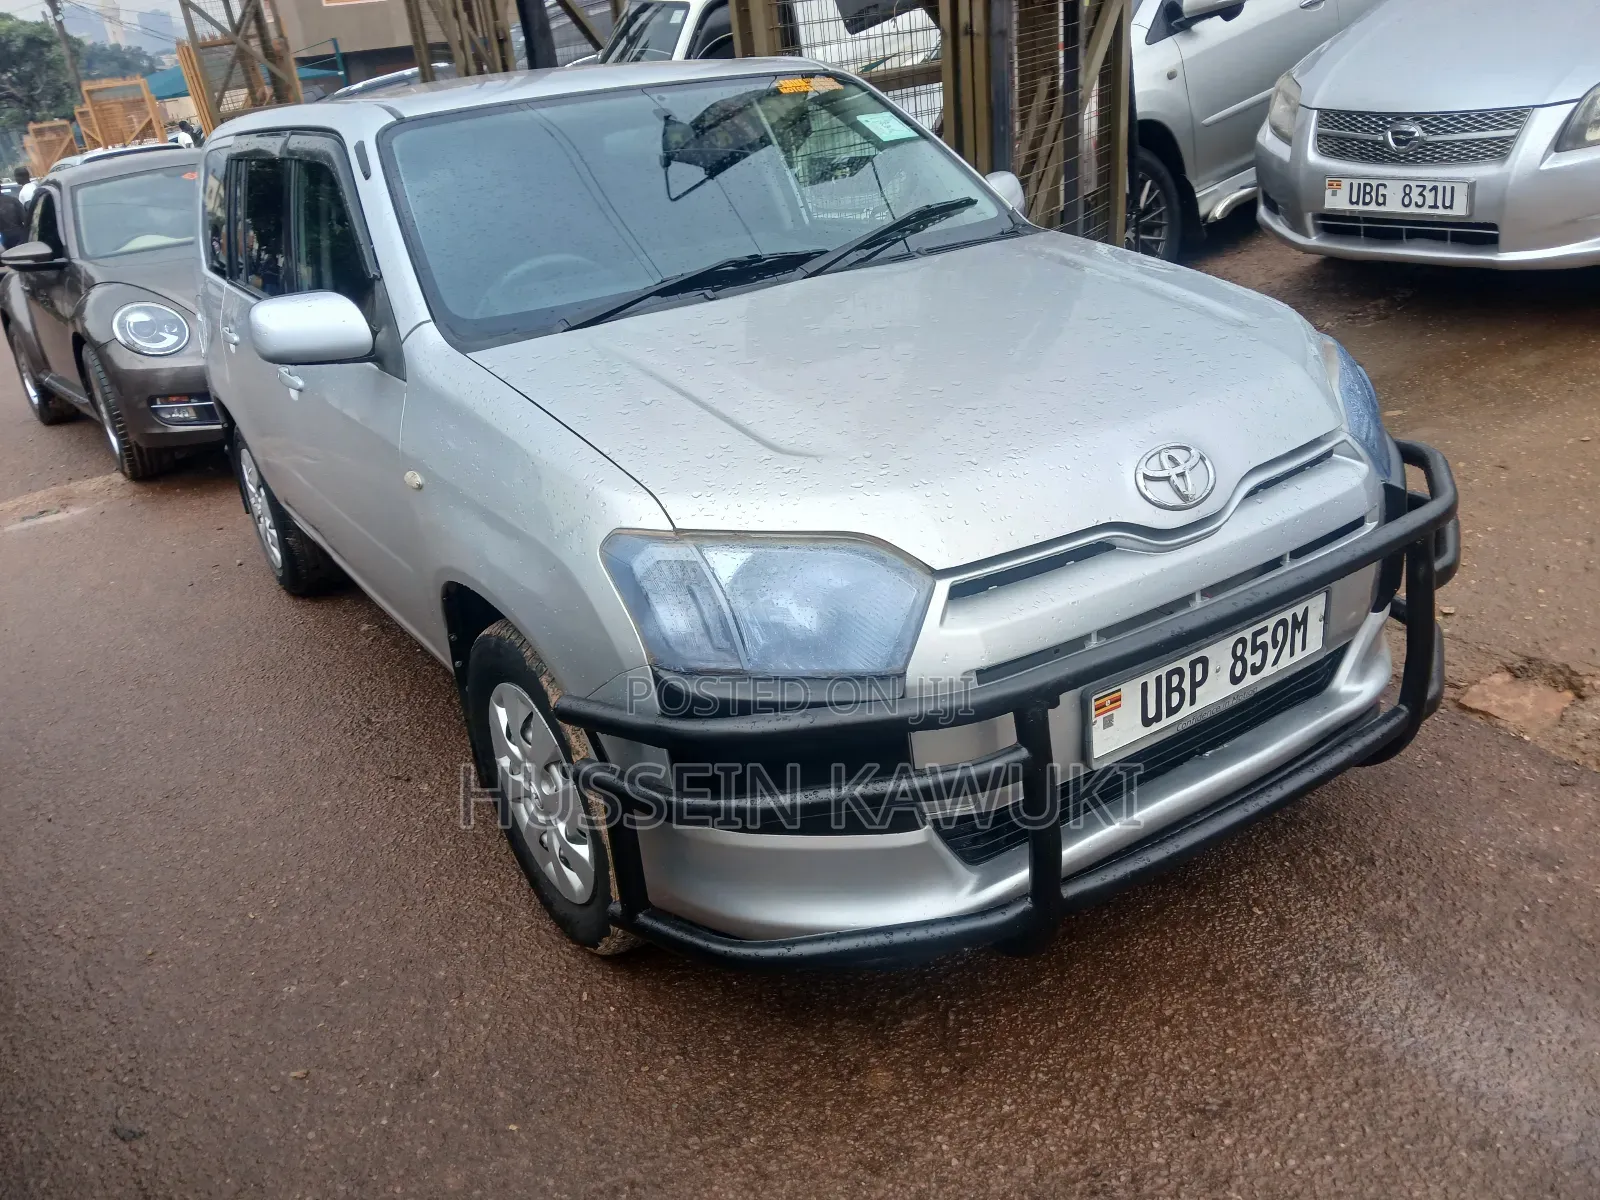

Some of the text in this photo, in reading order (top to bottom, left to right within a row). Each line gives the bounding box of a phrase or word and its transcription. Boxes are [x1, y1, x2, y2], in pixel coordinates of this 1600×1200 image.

[1348, 181, 1455, 210] UBG 831U
[1140, 605, 1309, 728] UBP 859M
